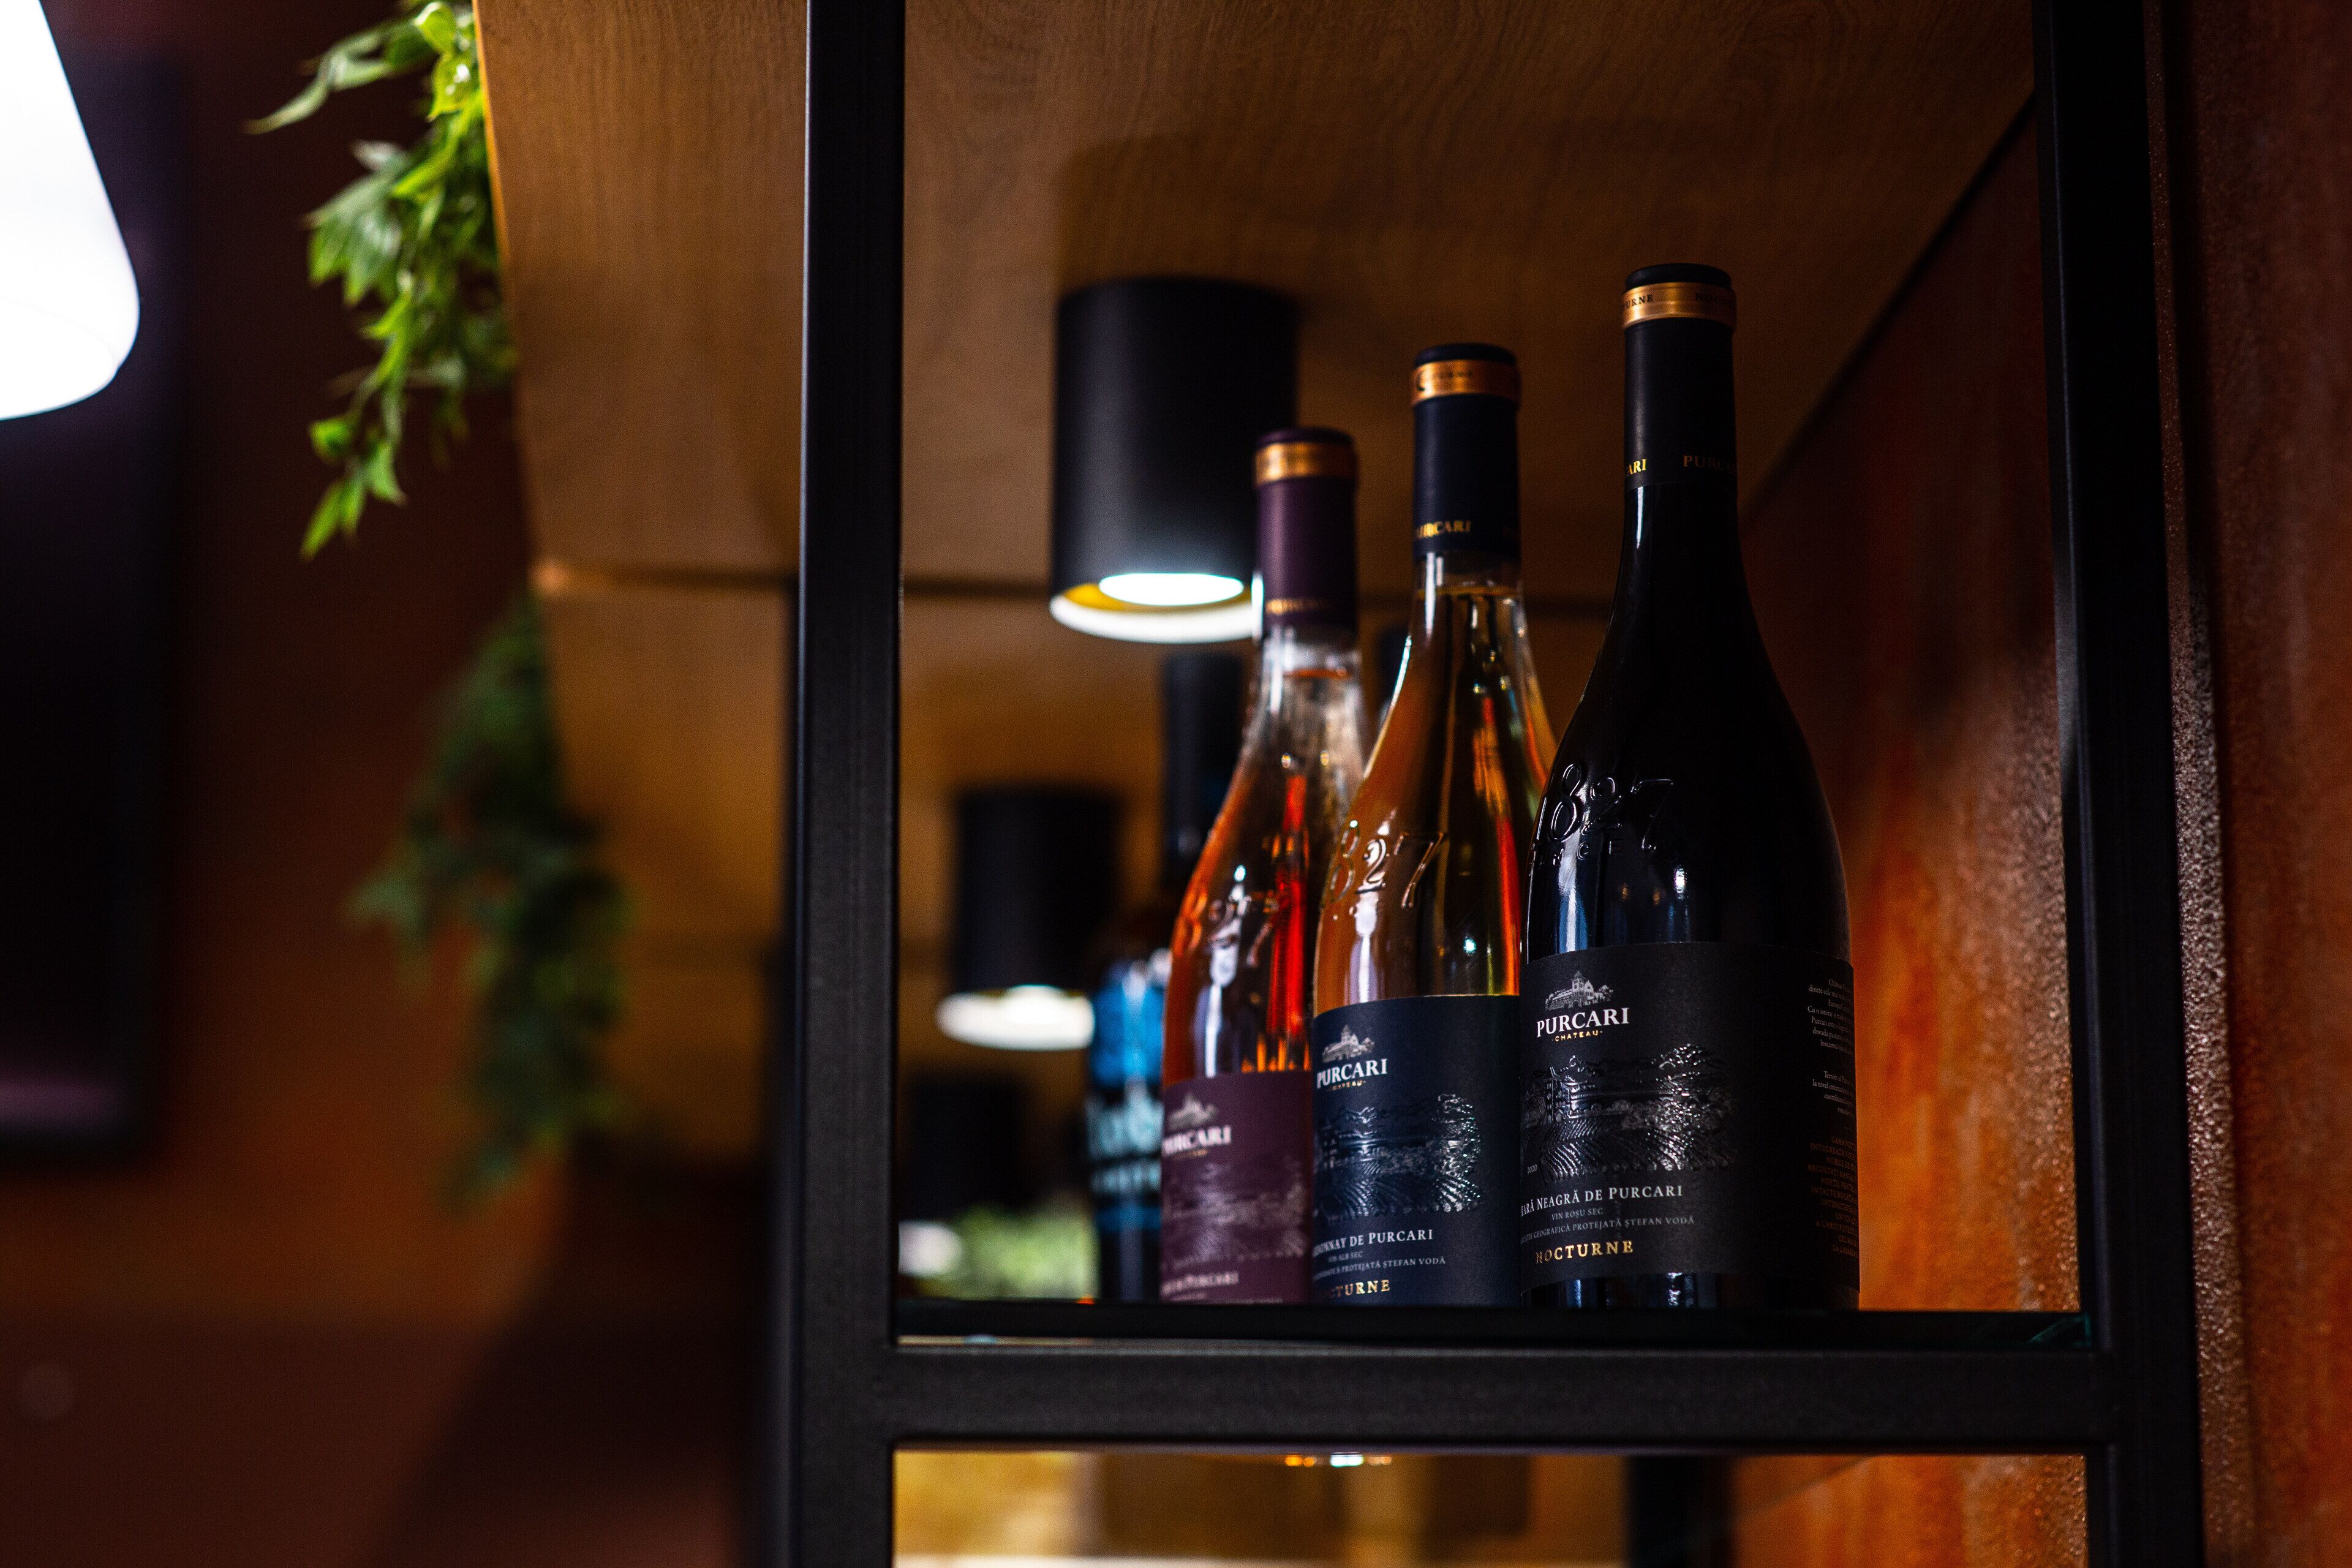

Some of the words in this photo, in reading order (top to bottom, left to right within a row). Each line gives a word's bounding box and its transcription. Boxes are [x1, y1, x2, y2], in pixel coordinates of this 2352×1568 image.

[1537, 1007, 1630, 1038] PURCARI
[1316, 1058, 1388, 1089] PURCARI
[1537, 1189, 1580, 1210] NEAGRĂ
[1585, 1189, 1602, 1202] DE
[1608, 1185, 1683, 1200] PURCARI
[1551, 1212, 1563, 1221] VIN
[1588, 1207, 1604, 1216] SEC
[1572, 1218, 1622, 1231] PROTEJATĂ
[1665, 1215, 1695, 1225] VODĂ
[1349, 1235, 1364, 1247] DE
[1368, 1229, 1433, 1245] PURCARI
[1536, 1240, 1634, 1265] NOCTURNE
